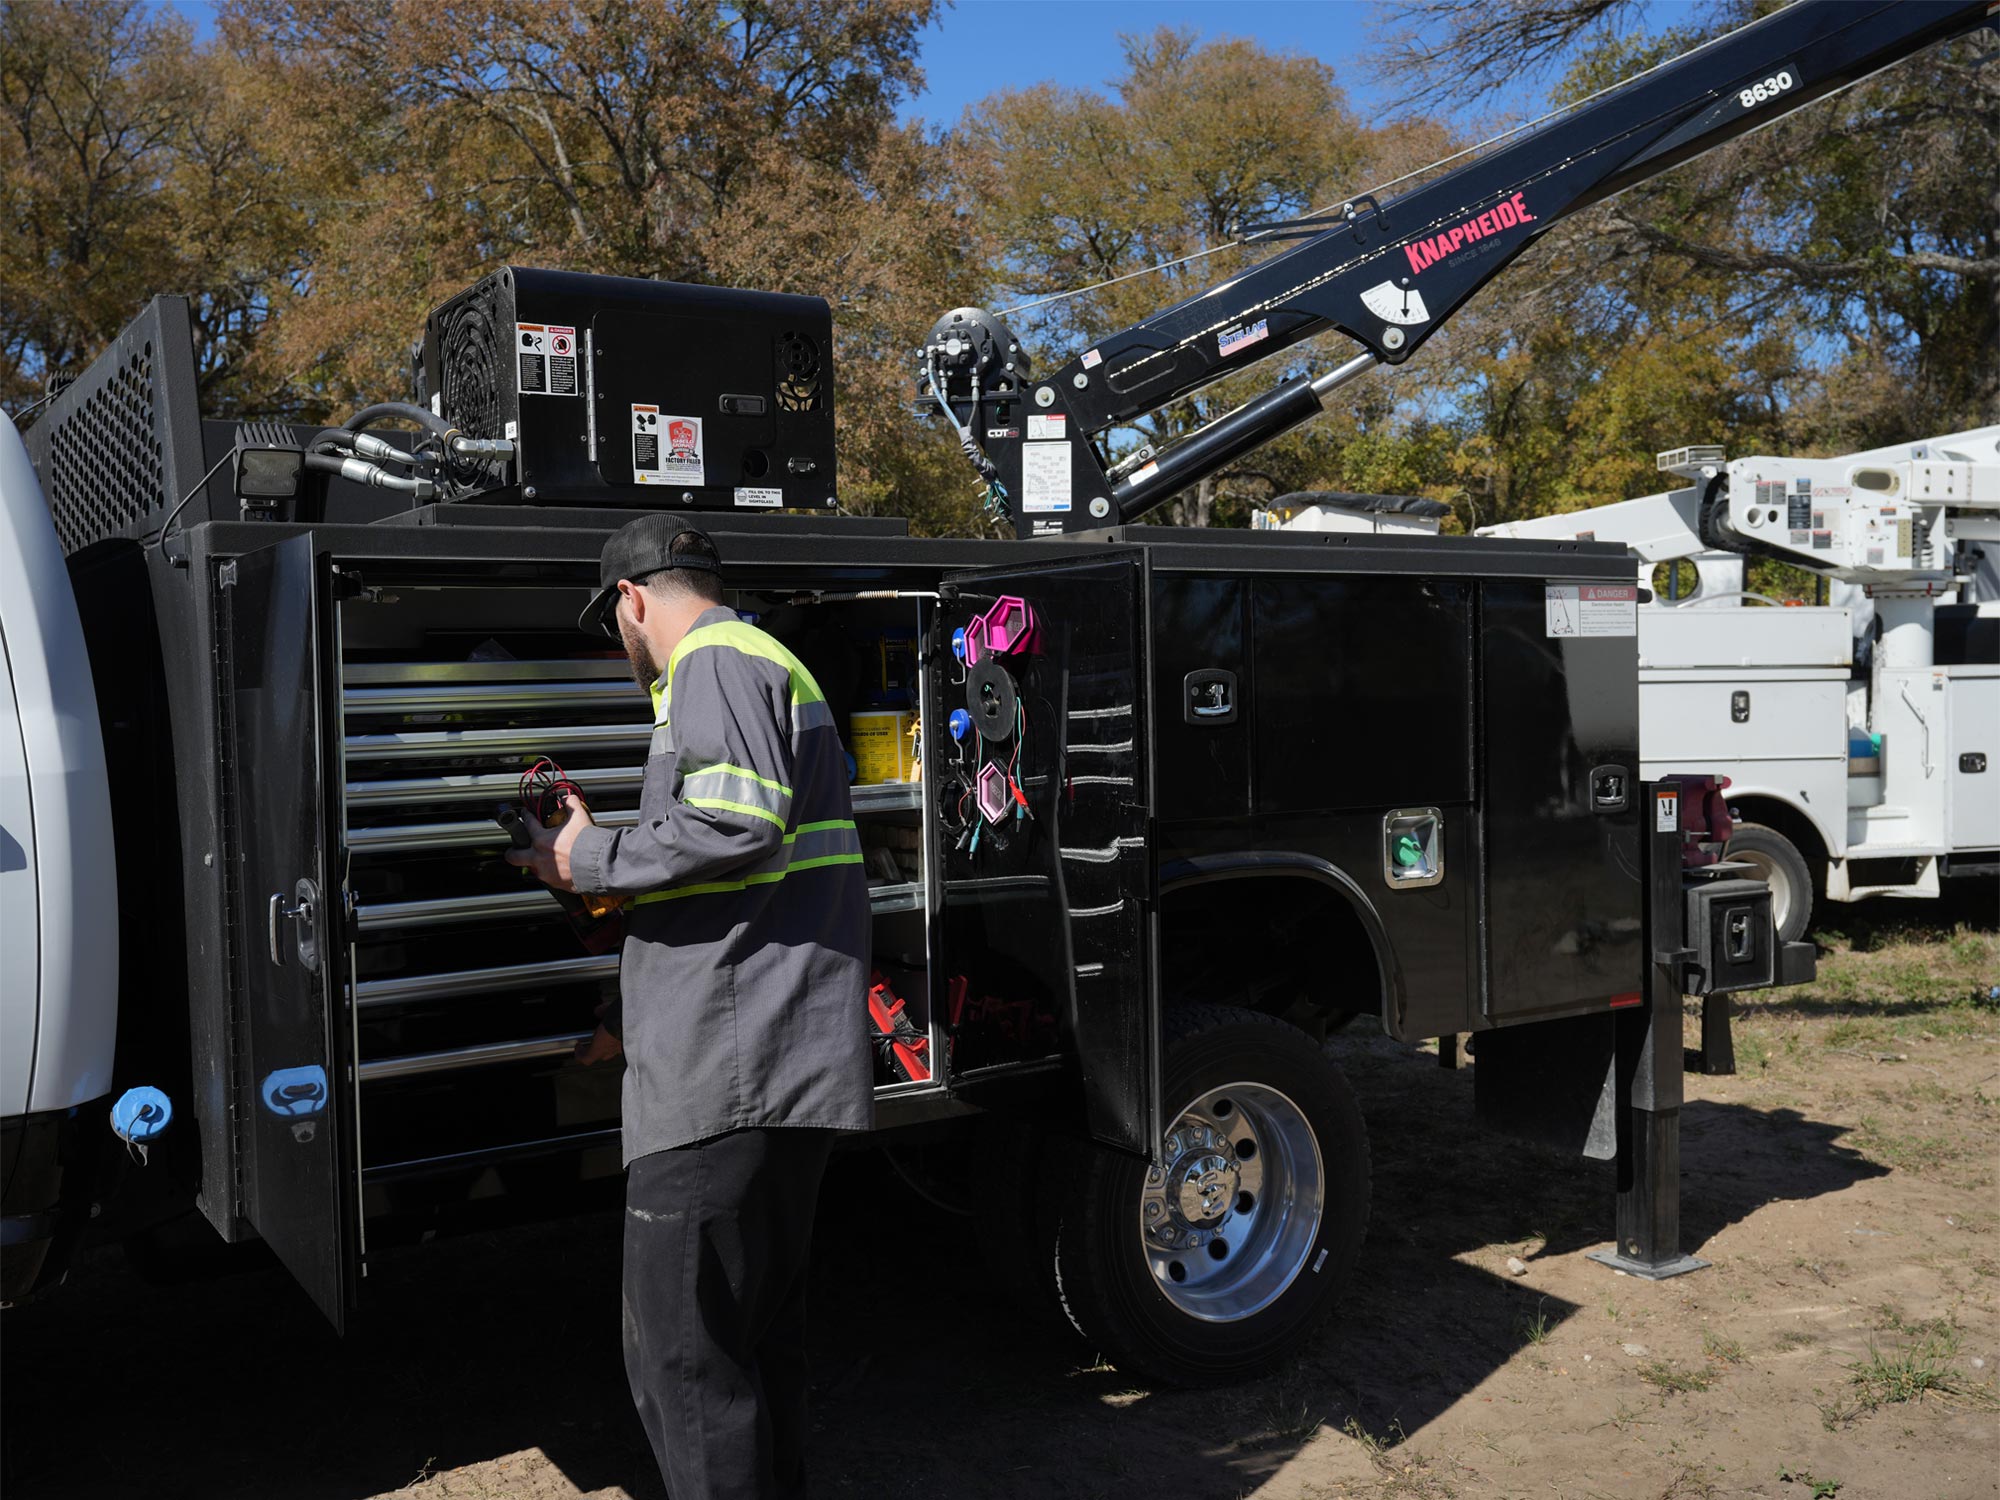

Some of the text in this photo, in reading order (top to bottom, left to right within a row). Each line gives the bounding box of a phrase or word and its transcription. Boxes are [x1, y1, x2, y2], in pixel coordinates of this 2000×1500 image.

[1739, 71, 1793, 108] 8630
[1404, 191, 1534, 275] KNAPHEIDE
[1448, 249, 1478, 268] SINCE
[1597, 589, 1629, 599] DANGER
